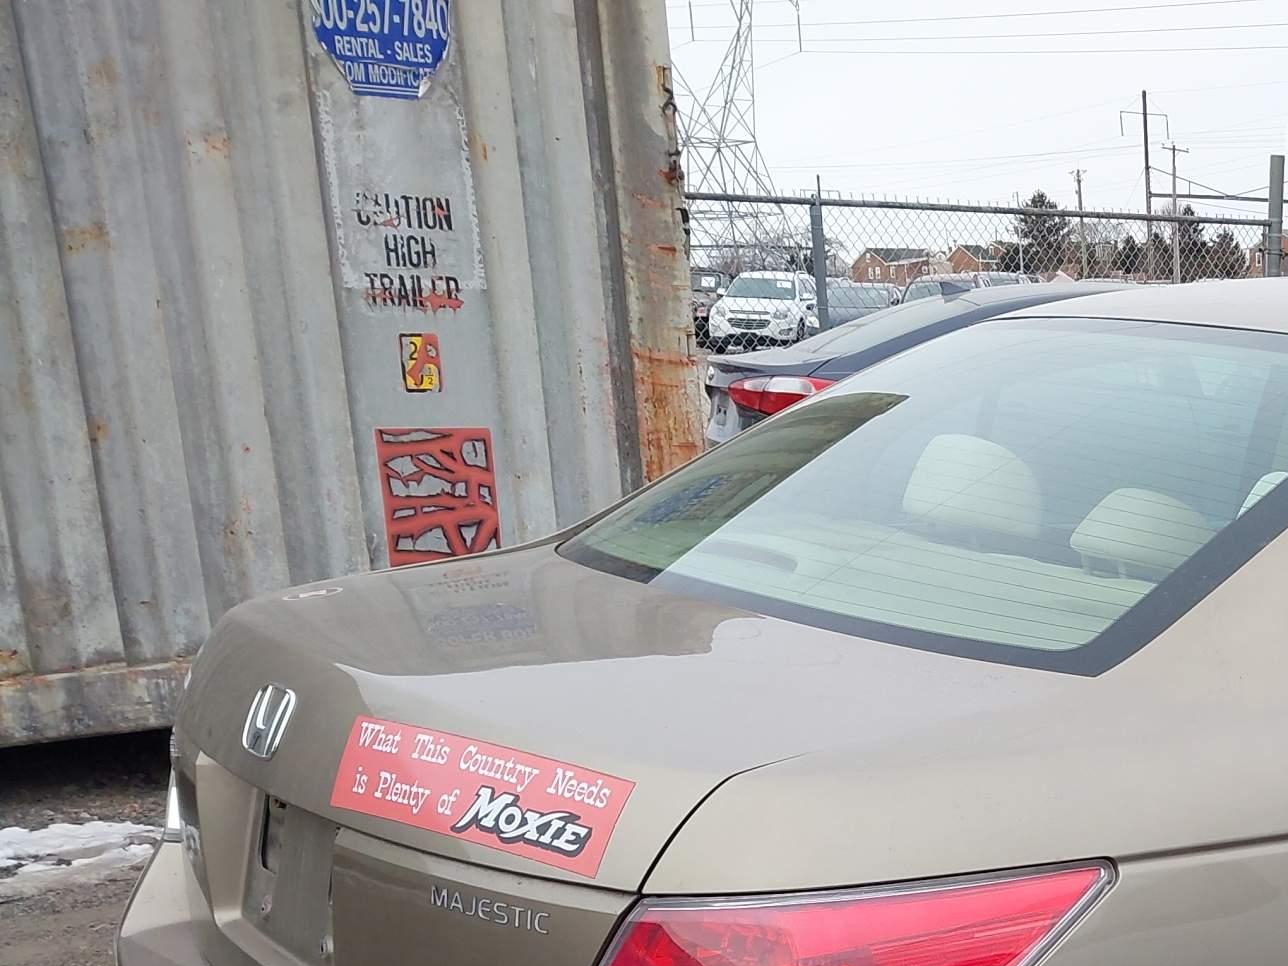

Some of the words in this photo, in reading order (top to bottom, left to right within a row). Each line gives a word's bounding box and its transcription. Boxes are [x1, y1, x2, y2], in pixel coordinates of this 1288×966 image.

[313, 0, 449, 40] 00-257-7840
[334, 35, 384, 59] RENTAL
[394, 40, 433, 64] SALES
[384, 233, 437, 269] HIGH
[358, 721, 402, 754] What
[411, 733, 450, 765] This
[459, 745, 540, 791] Country
[546, 767, 612, 808] Needs
[352, 766, 369, 794] is
[374, 771, 431, 814] Plenty
[437, 789, 460, 815] of
[430, 885, 549, 935] MAJESTIC
